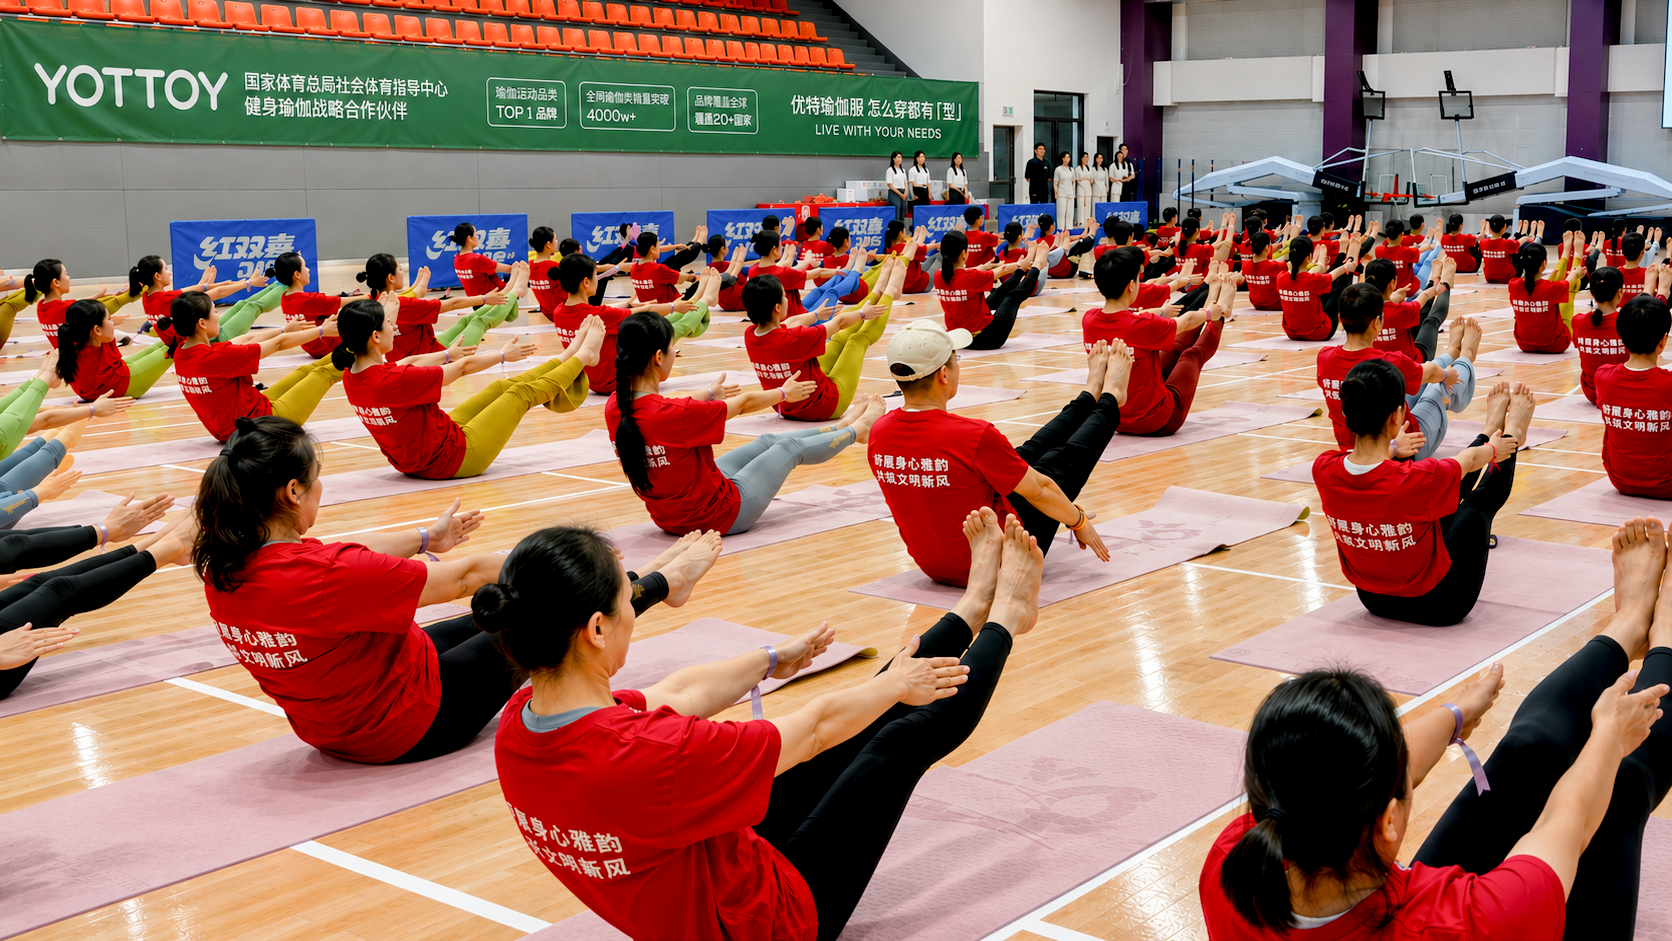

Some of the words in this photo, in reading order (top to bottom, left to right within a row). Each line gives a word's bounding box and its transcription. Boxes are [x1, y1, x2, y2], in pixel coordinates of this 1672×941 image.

[34, 62, 229, 111] YOTTOY
[244, 72, 449, 98] 国家体育总局社会体育指导中心
[244, 96, 408, 120] 健身瑜伽战略合作伙伴
[496, 105, 524, 119] TOP
[527, 107, 533, 119] 1
[536, 107, 558, 120] 品牌
[586, 108, 636, 122] 4000w+
[791, 95, 864, 117] 优特瑜伽服
[815, 124, 840, 136] LIVE
[843, 125, 872, 137] WITH
[874, 126, 904, 138] YOUR
[907, 128, 942, 139] NEEDS
